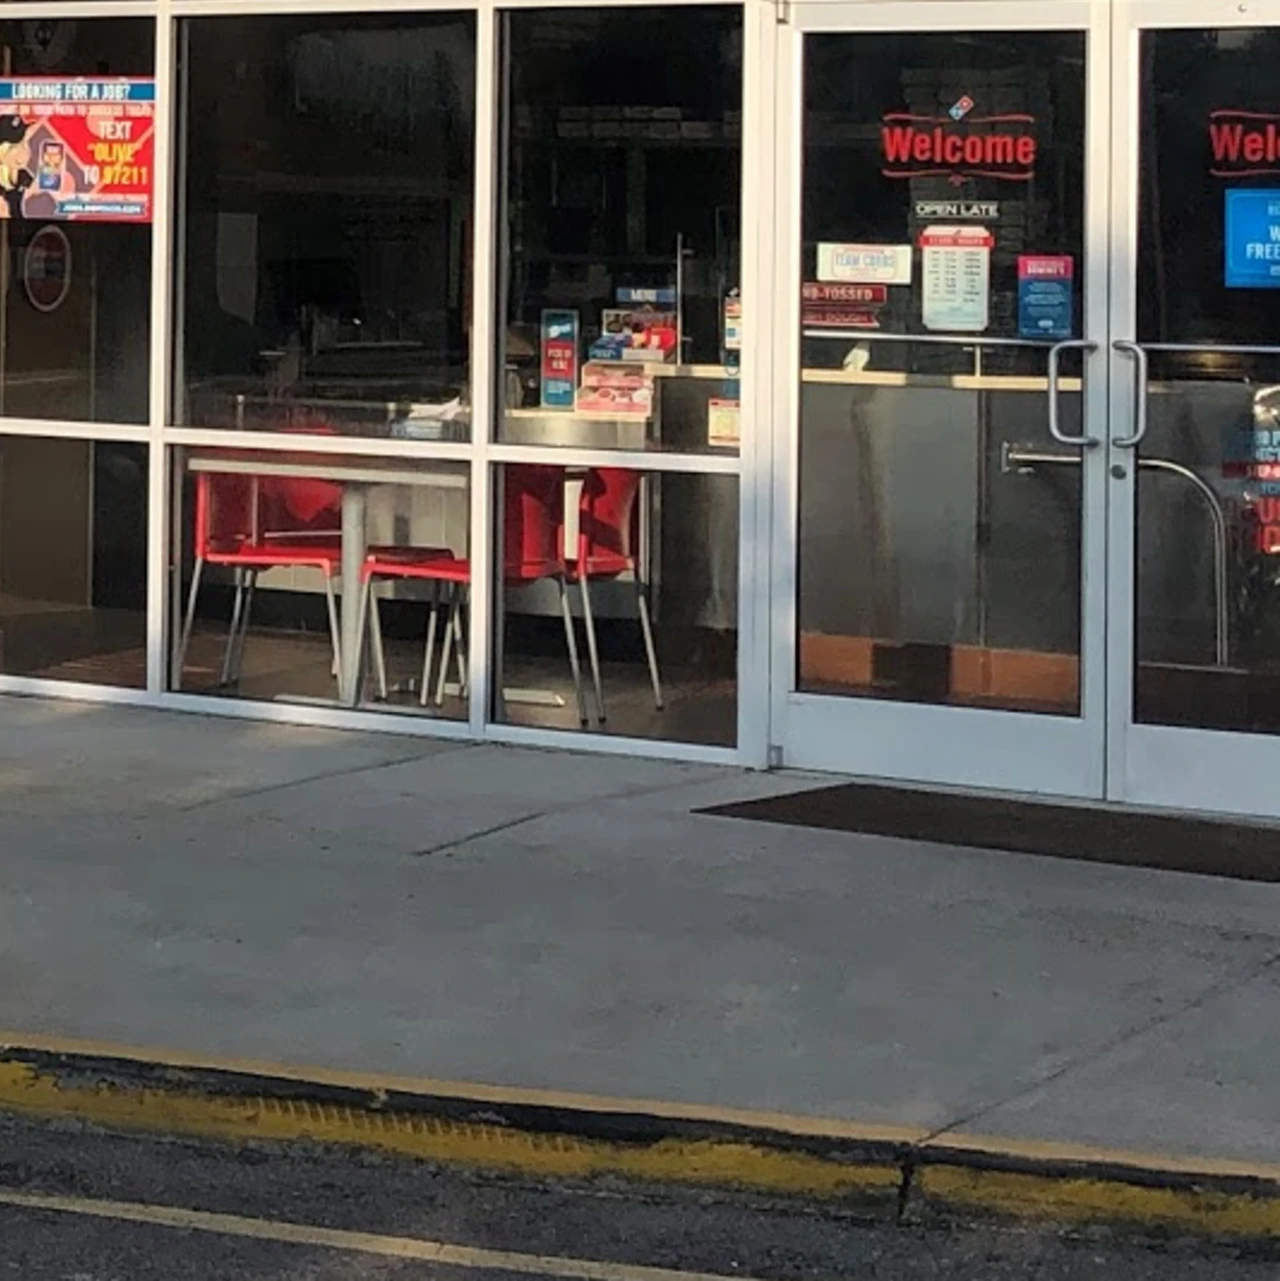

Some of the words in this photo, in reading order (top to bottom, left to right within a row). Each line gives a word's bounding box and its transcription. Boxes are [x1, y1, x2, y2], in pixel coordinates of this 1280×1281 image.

[12, 83, 62, 100] LOOKING
[64, 83, 88, 100] FOR
[91, 83, 101, 100] A
[99, 121, 133, 140] TEXT
[882, 125, 1036, 165] Welcome
[1208, 123, 1280, 162] Wel
[83, 165, 100, 185] TO
[915, 203, 957, 217] OPEN
[961, 202, 1000, 217] LATE
